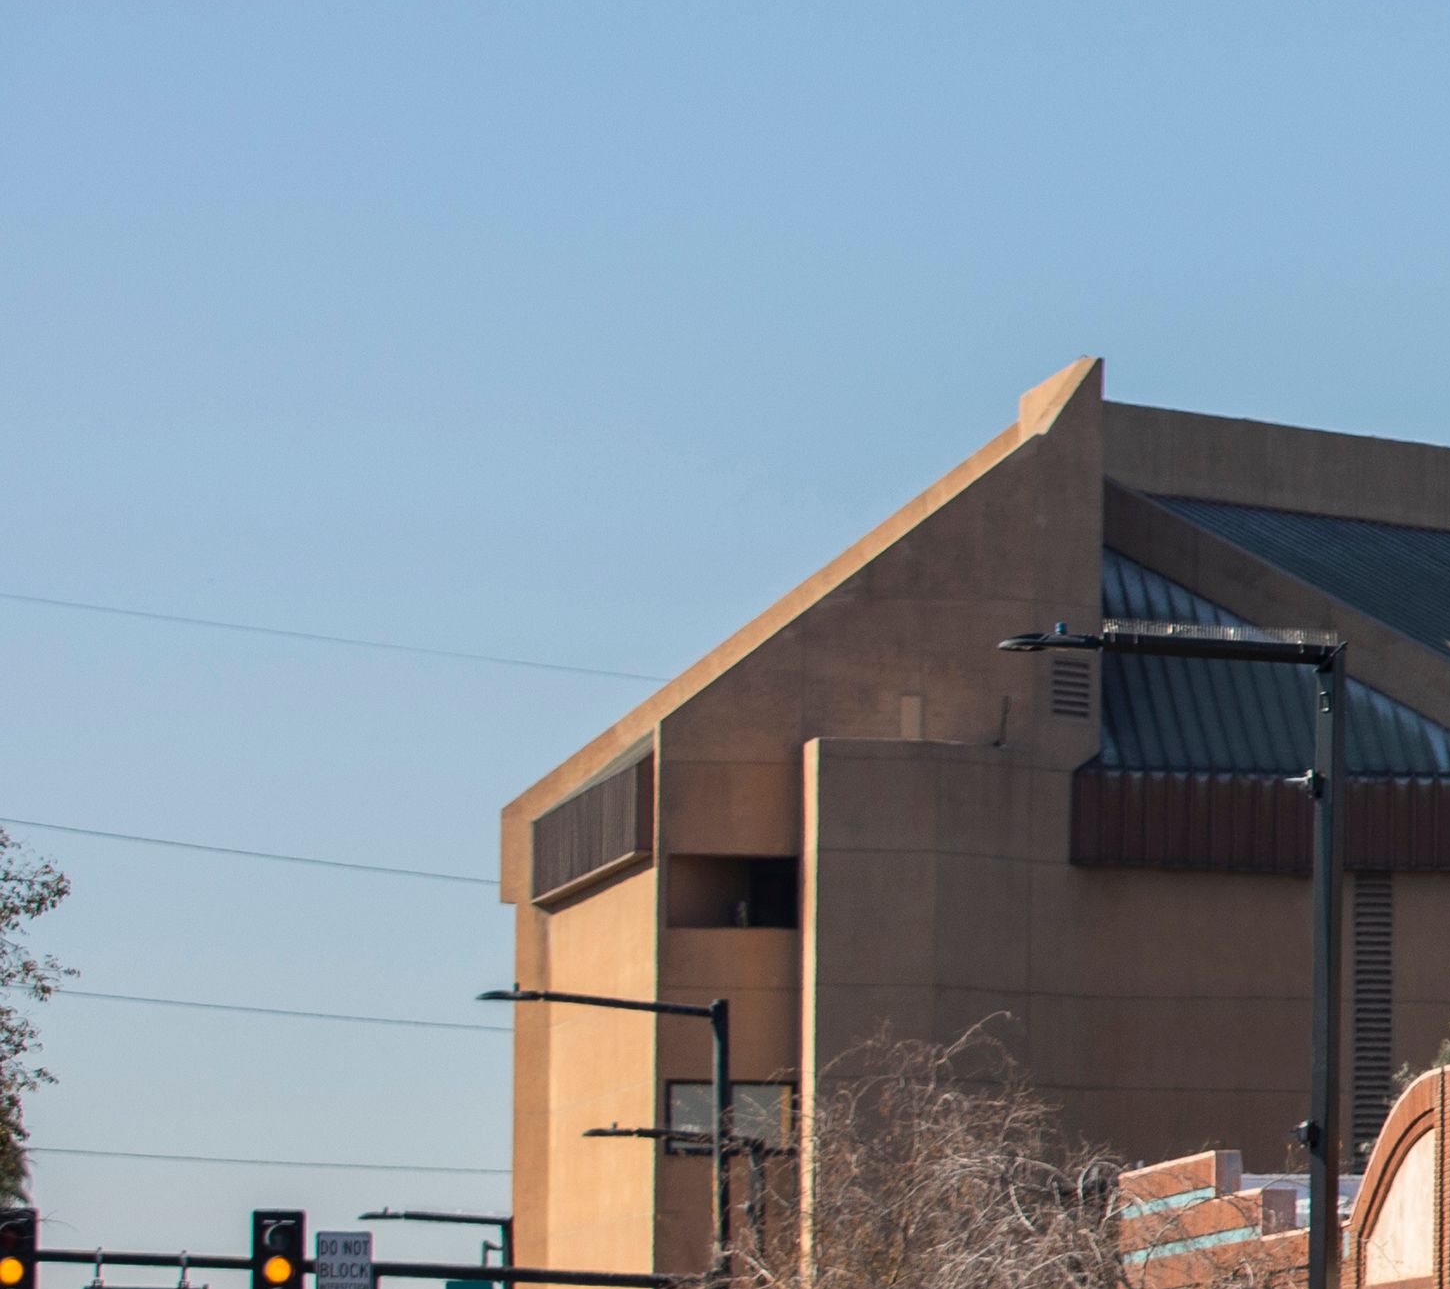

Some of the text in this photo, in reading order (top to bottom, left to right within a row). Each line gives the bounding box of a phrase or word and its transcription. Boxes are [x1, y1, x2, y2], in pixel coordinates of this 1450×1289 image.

[320, 1240, 370, 1256] DO NOT
[320, 1262, 369, 1278] BLOCK
